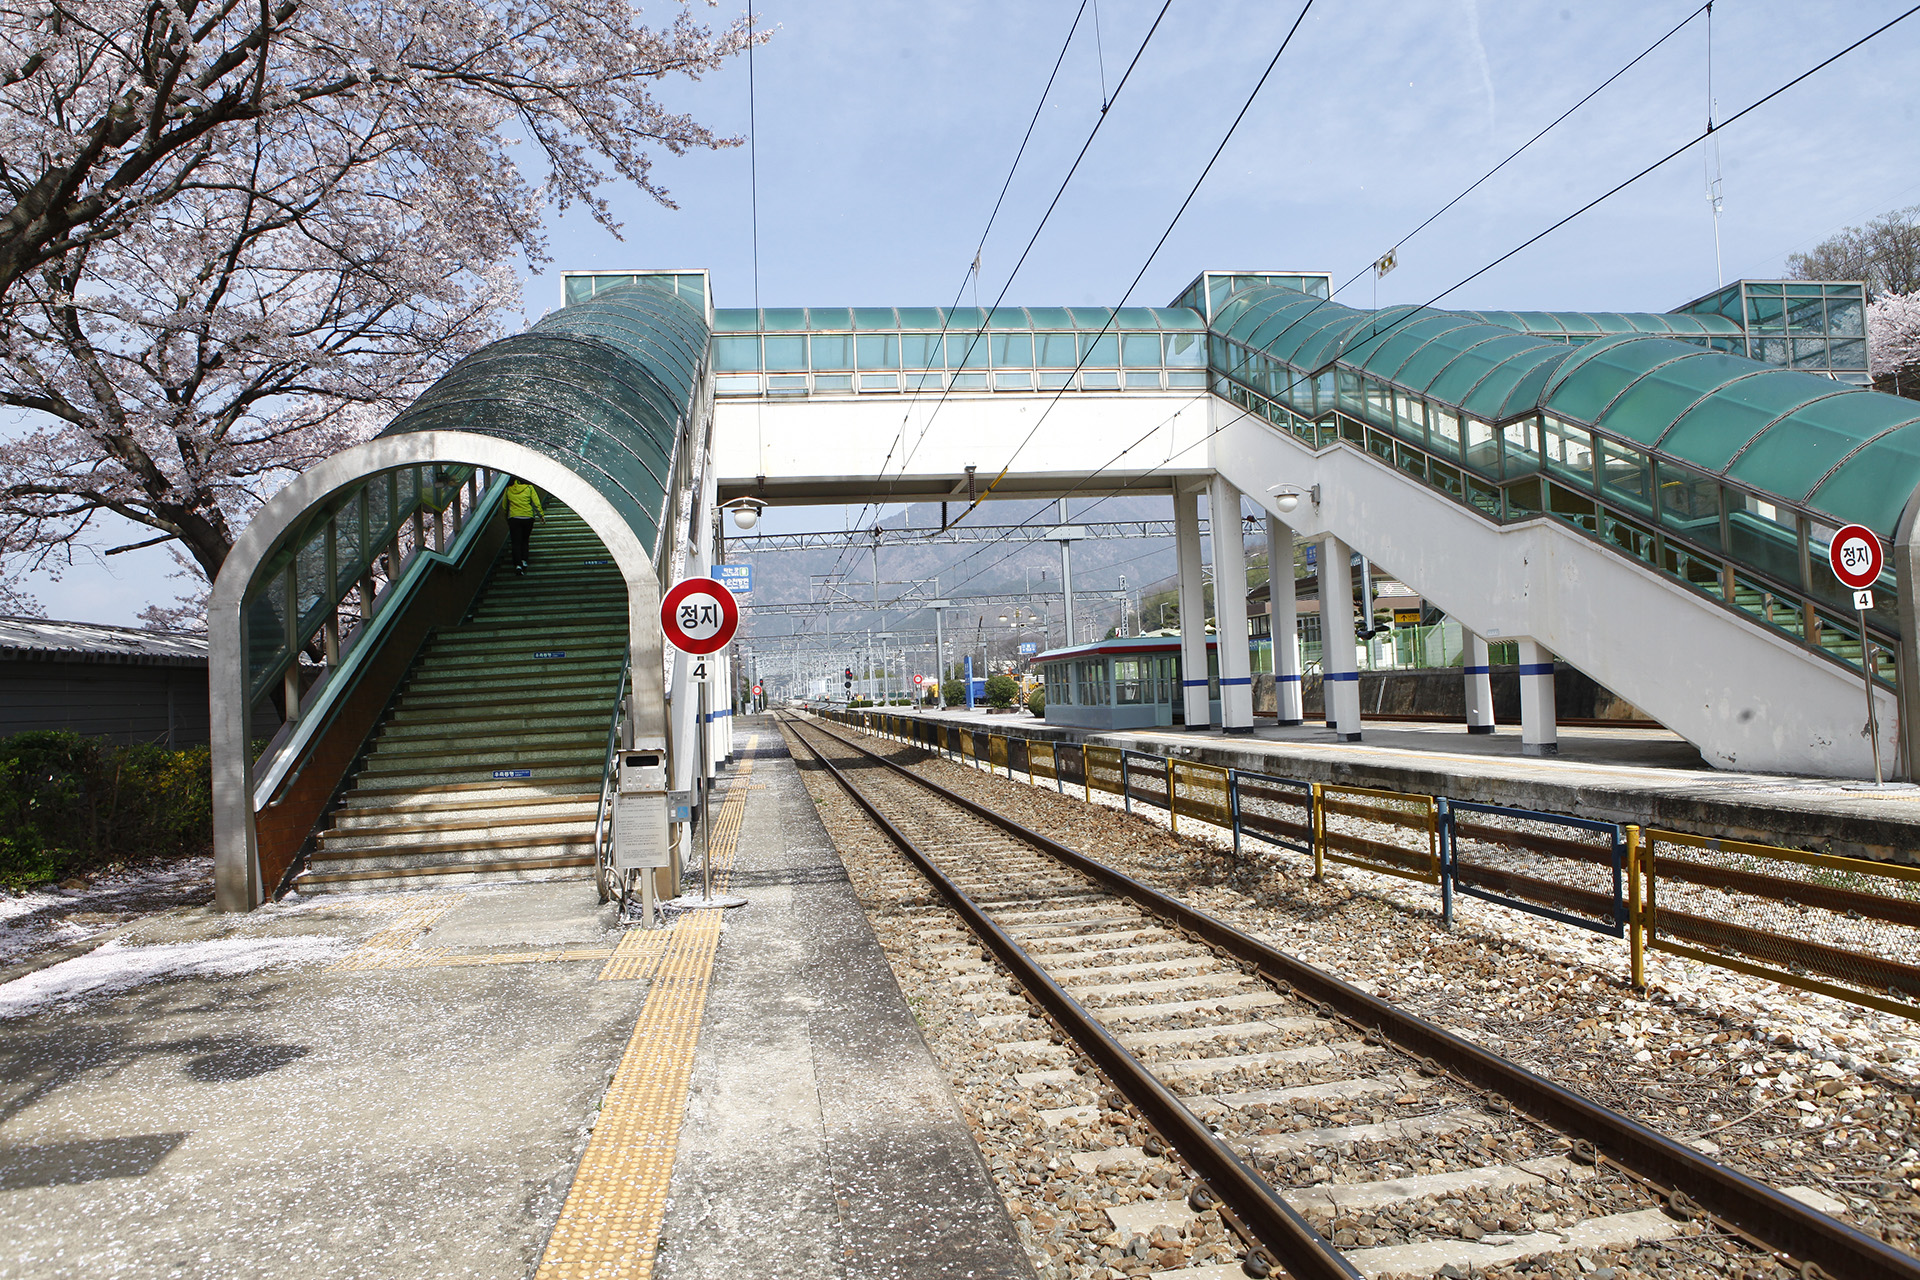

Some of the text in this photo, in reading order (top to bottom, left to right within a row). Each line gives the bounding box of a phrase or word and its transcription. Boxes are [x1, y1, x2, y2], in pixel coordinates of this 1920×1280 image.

[1843, 546, 1869, 567] 정지
[1859, 593, 1869, 606] 4
[680, 603, 718, 629] 정지
[693, 663, 707, 680] 4
